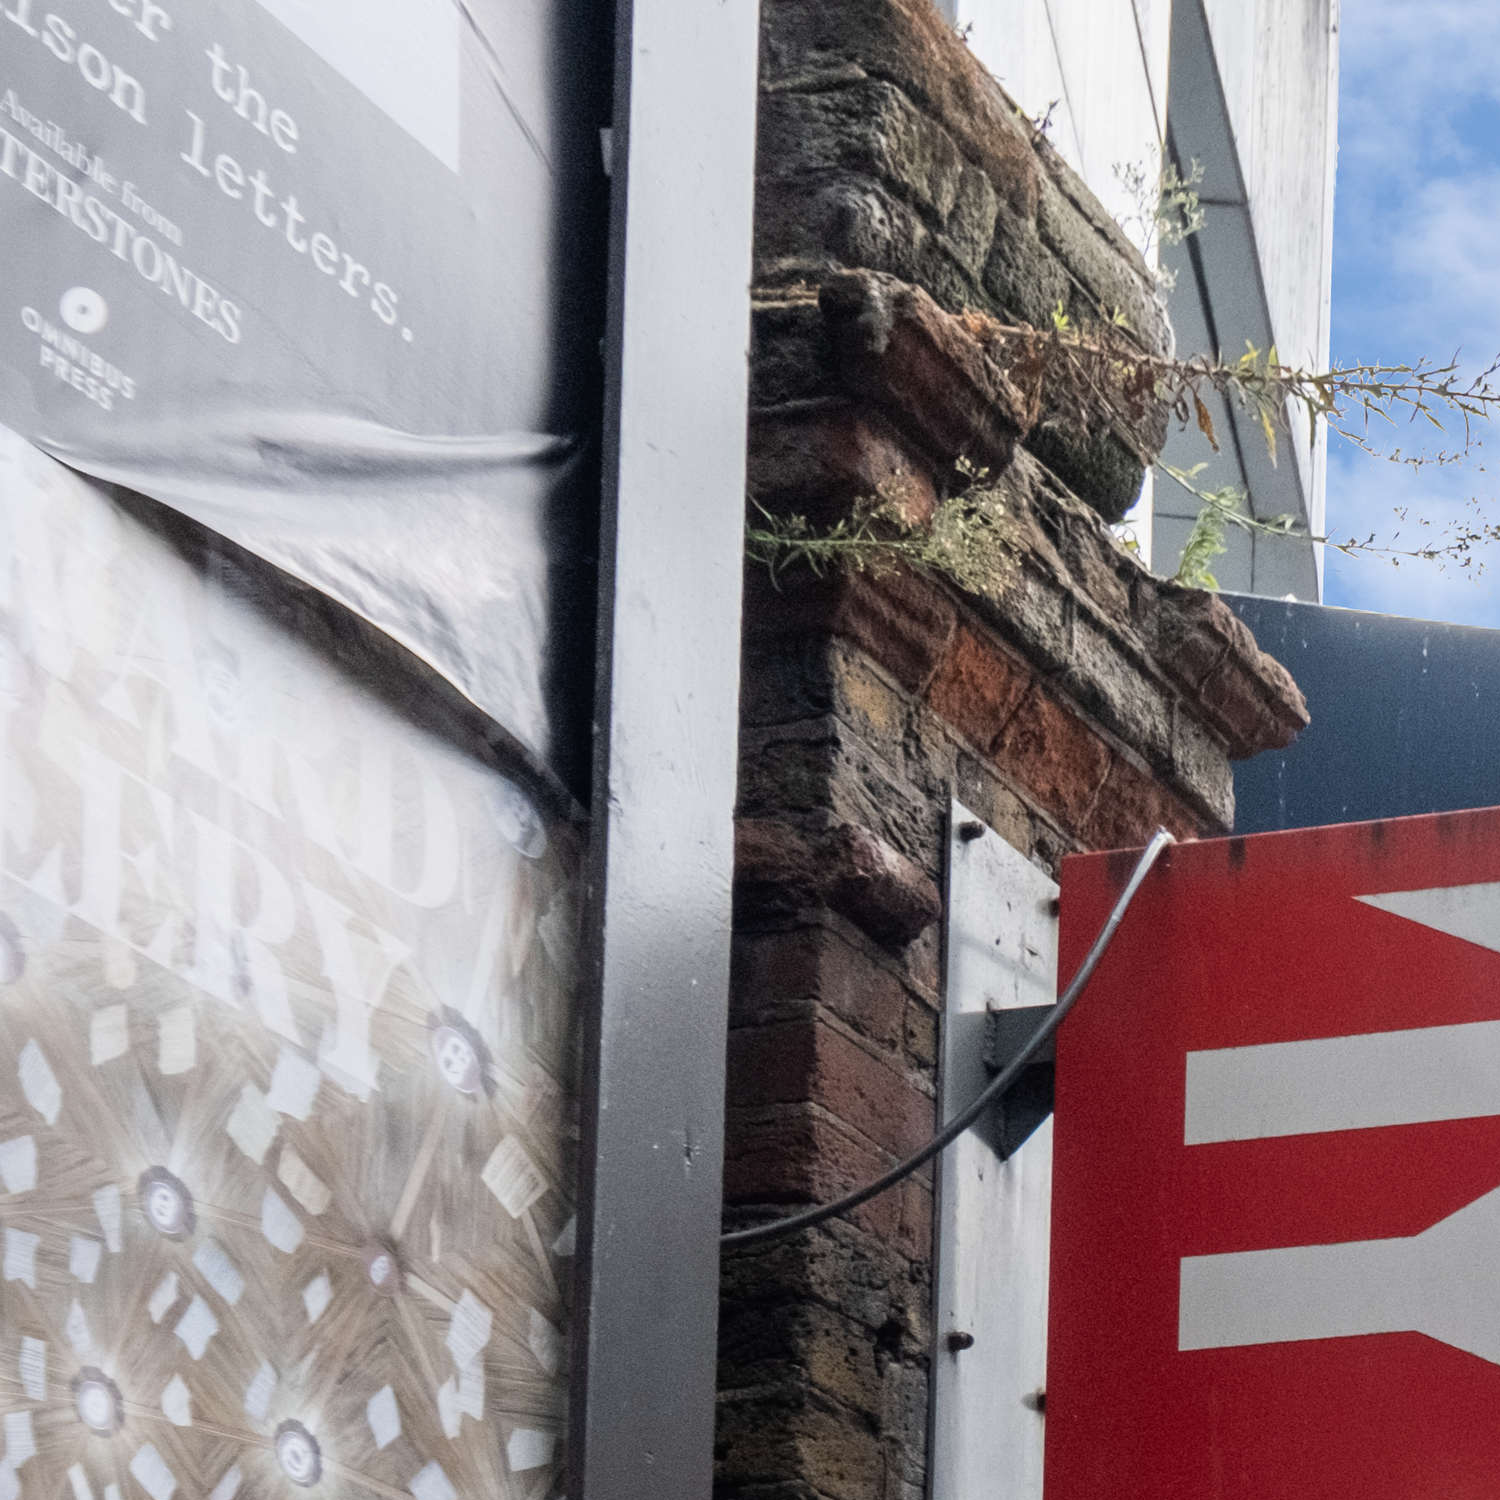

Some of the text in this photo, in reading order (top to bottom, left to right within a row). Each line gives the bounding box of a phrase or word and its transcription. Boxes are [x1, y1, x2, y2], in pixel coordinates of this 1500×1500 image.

[206, 43, 299, 153] the
[0, 88, 183, 247] Available from
[181, 108, 413, 344] letters.
[20, 306, 136, 400] OMNIBUS
[40, 344, 113, 411] PRESS
